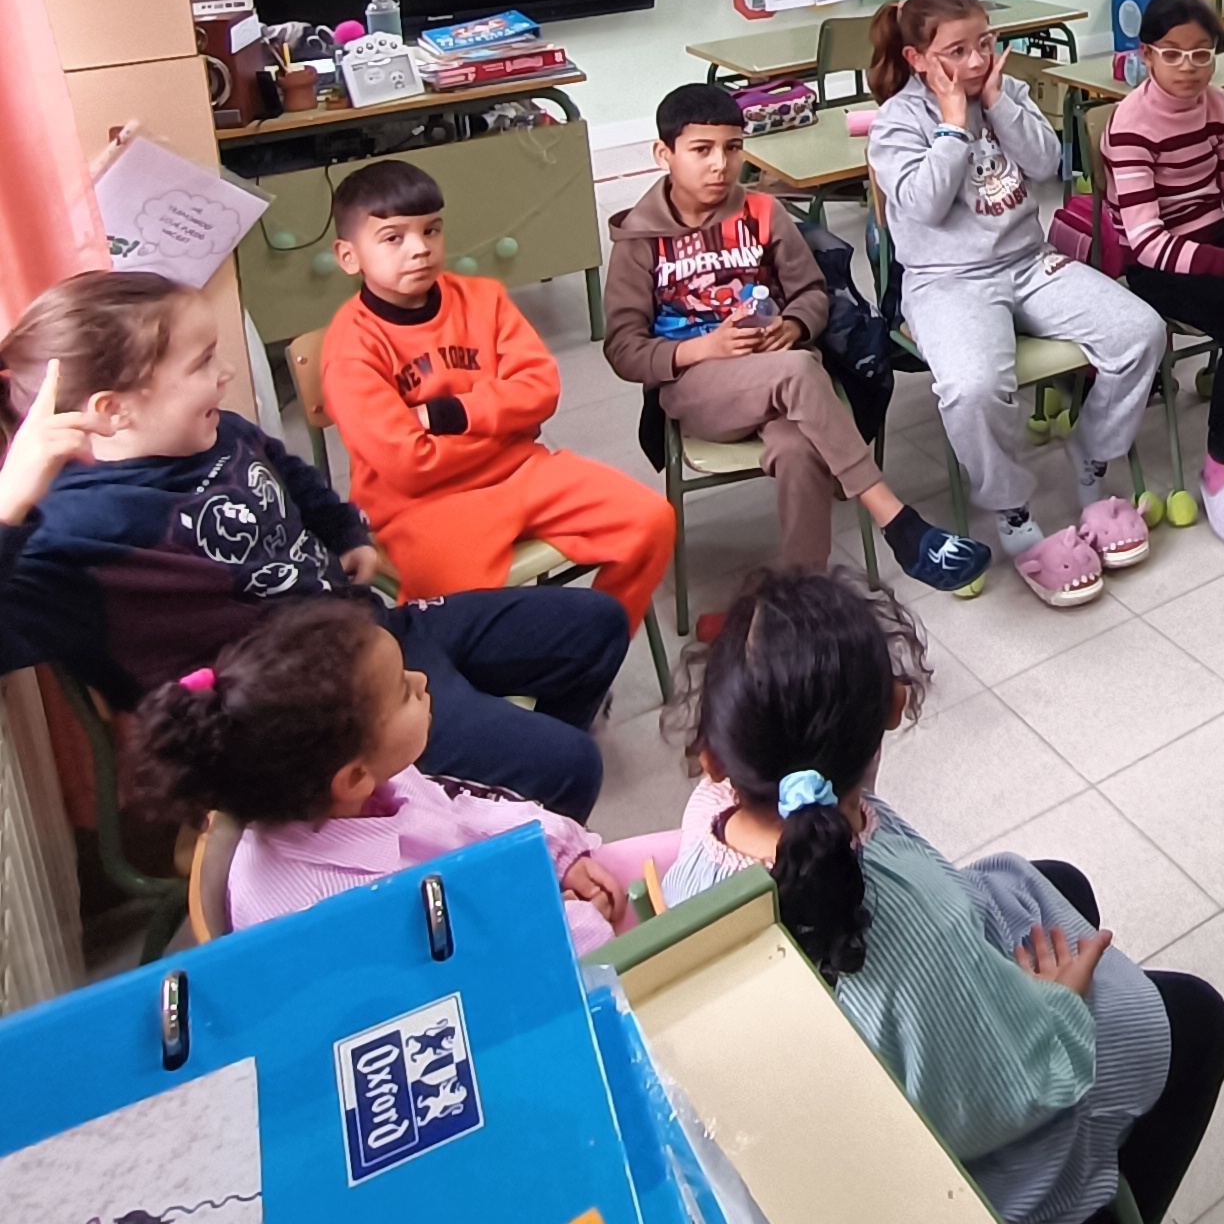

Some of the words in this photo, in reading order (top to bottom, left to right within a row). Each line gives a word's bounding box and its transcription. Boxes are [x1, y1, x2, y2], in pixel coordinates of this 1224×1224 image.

[394, 352, 434, 396] NEW
[437, 345, 481, 370] YORK
[356, 1044, 410, 1149] Oxford
